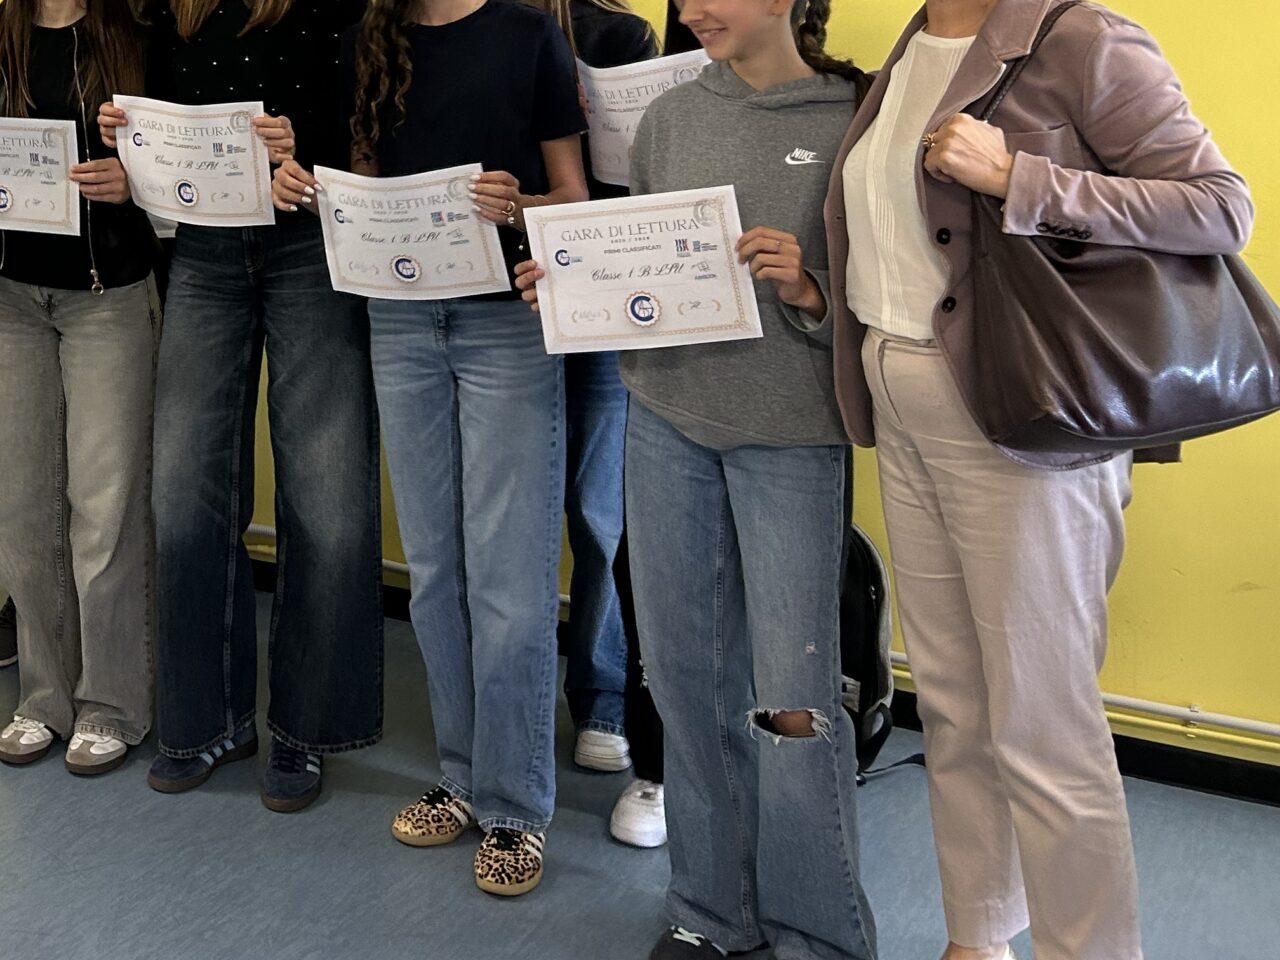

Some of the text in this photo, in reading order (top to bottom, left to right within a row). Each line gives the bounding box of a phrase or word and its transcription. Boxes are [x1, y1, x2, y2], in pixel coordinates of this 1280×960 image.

[139, 118, 233, 137] GARA DI LETTURA
[791, 147, 817, 161] NIKE
[561, 227, 603, 242] GARA
[608, 225, 622, 238] DI
[628, 218, 699, 235] LETTURA
